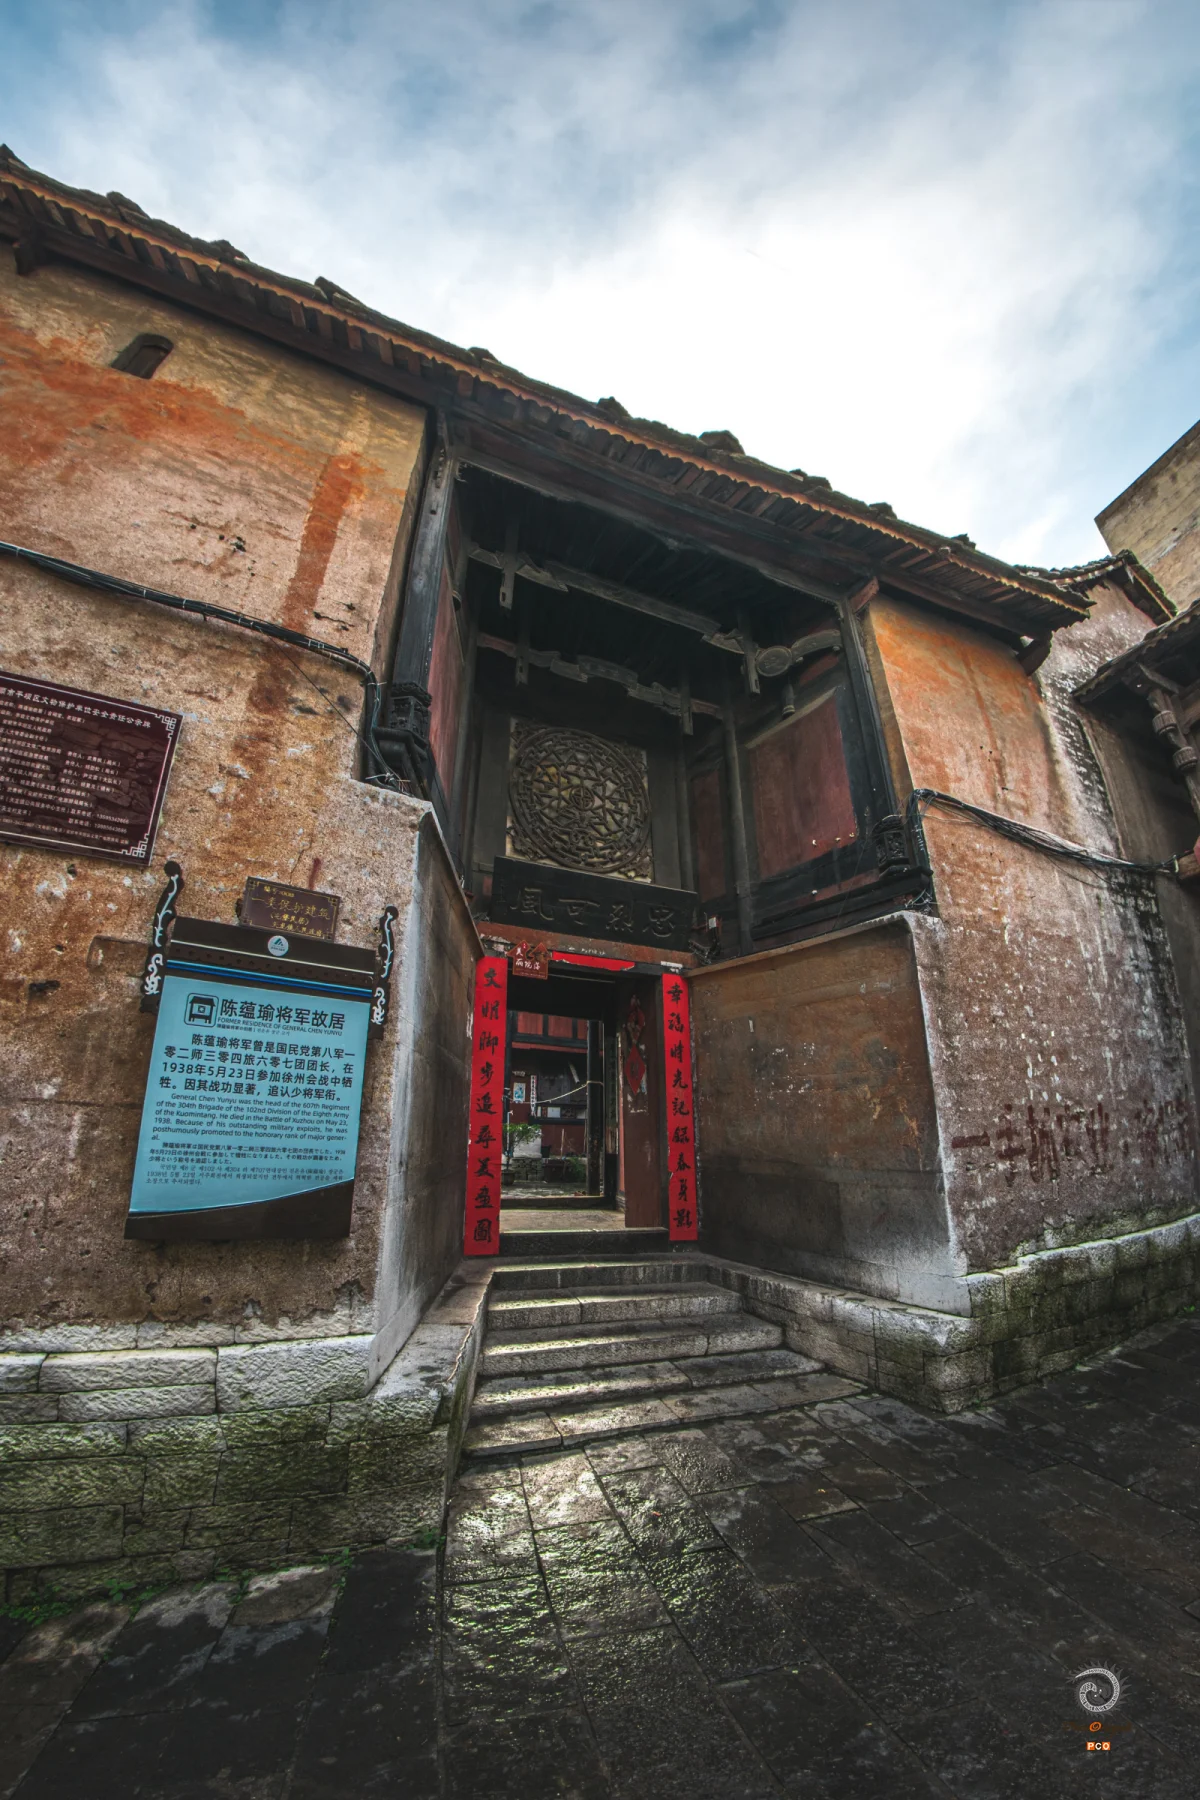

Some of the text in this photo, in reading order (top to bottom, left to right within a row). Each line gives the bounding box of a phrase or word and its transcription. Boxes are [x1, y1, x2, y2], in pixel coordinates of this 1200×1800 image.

[220, 999, 346, 1030] 陈蕴瑜将军故居
[242, 1020, 273, 1028] RESIDENCE
[192, 1034, 355, 1060] 陈蕴瑜将军曾是国民党第八军一
[164, 1047, 354, 1074] 零二师三零四旅六零七团团长，在
[162, 1062, 353, 1088] 1938年5月23日参加徐州会战中牺
[159, 1078, 342, 1101] 牲。因其战功显著，追认少将军衔。
[171, 1093, 197, 1101] General
[198, 1103, 224, 1111] Brigade
[176, 1110, 218, 1119] Kuomintang.
[152, 1126, 200, 1135] posthumously
[229, 1122, 268, 1130] outstanding
